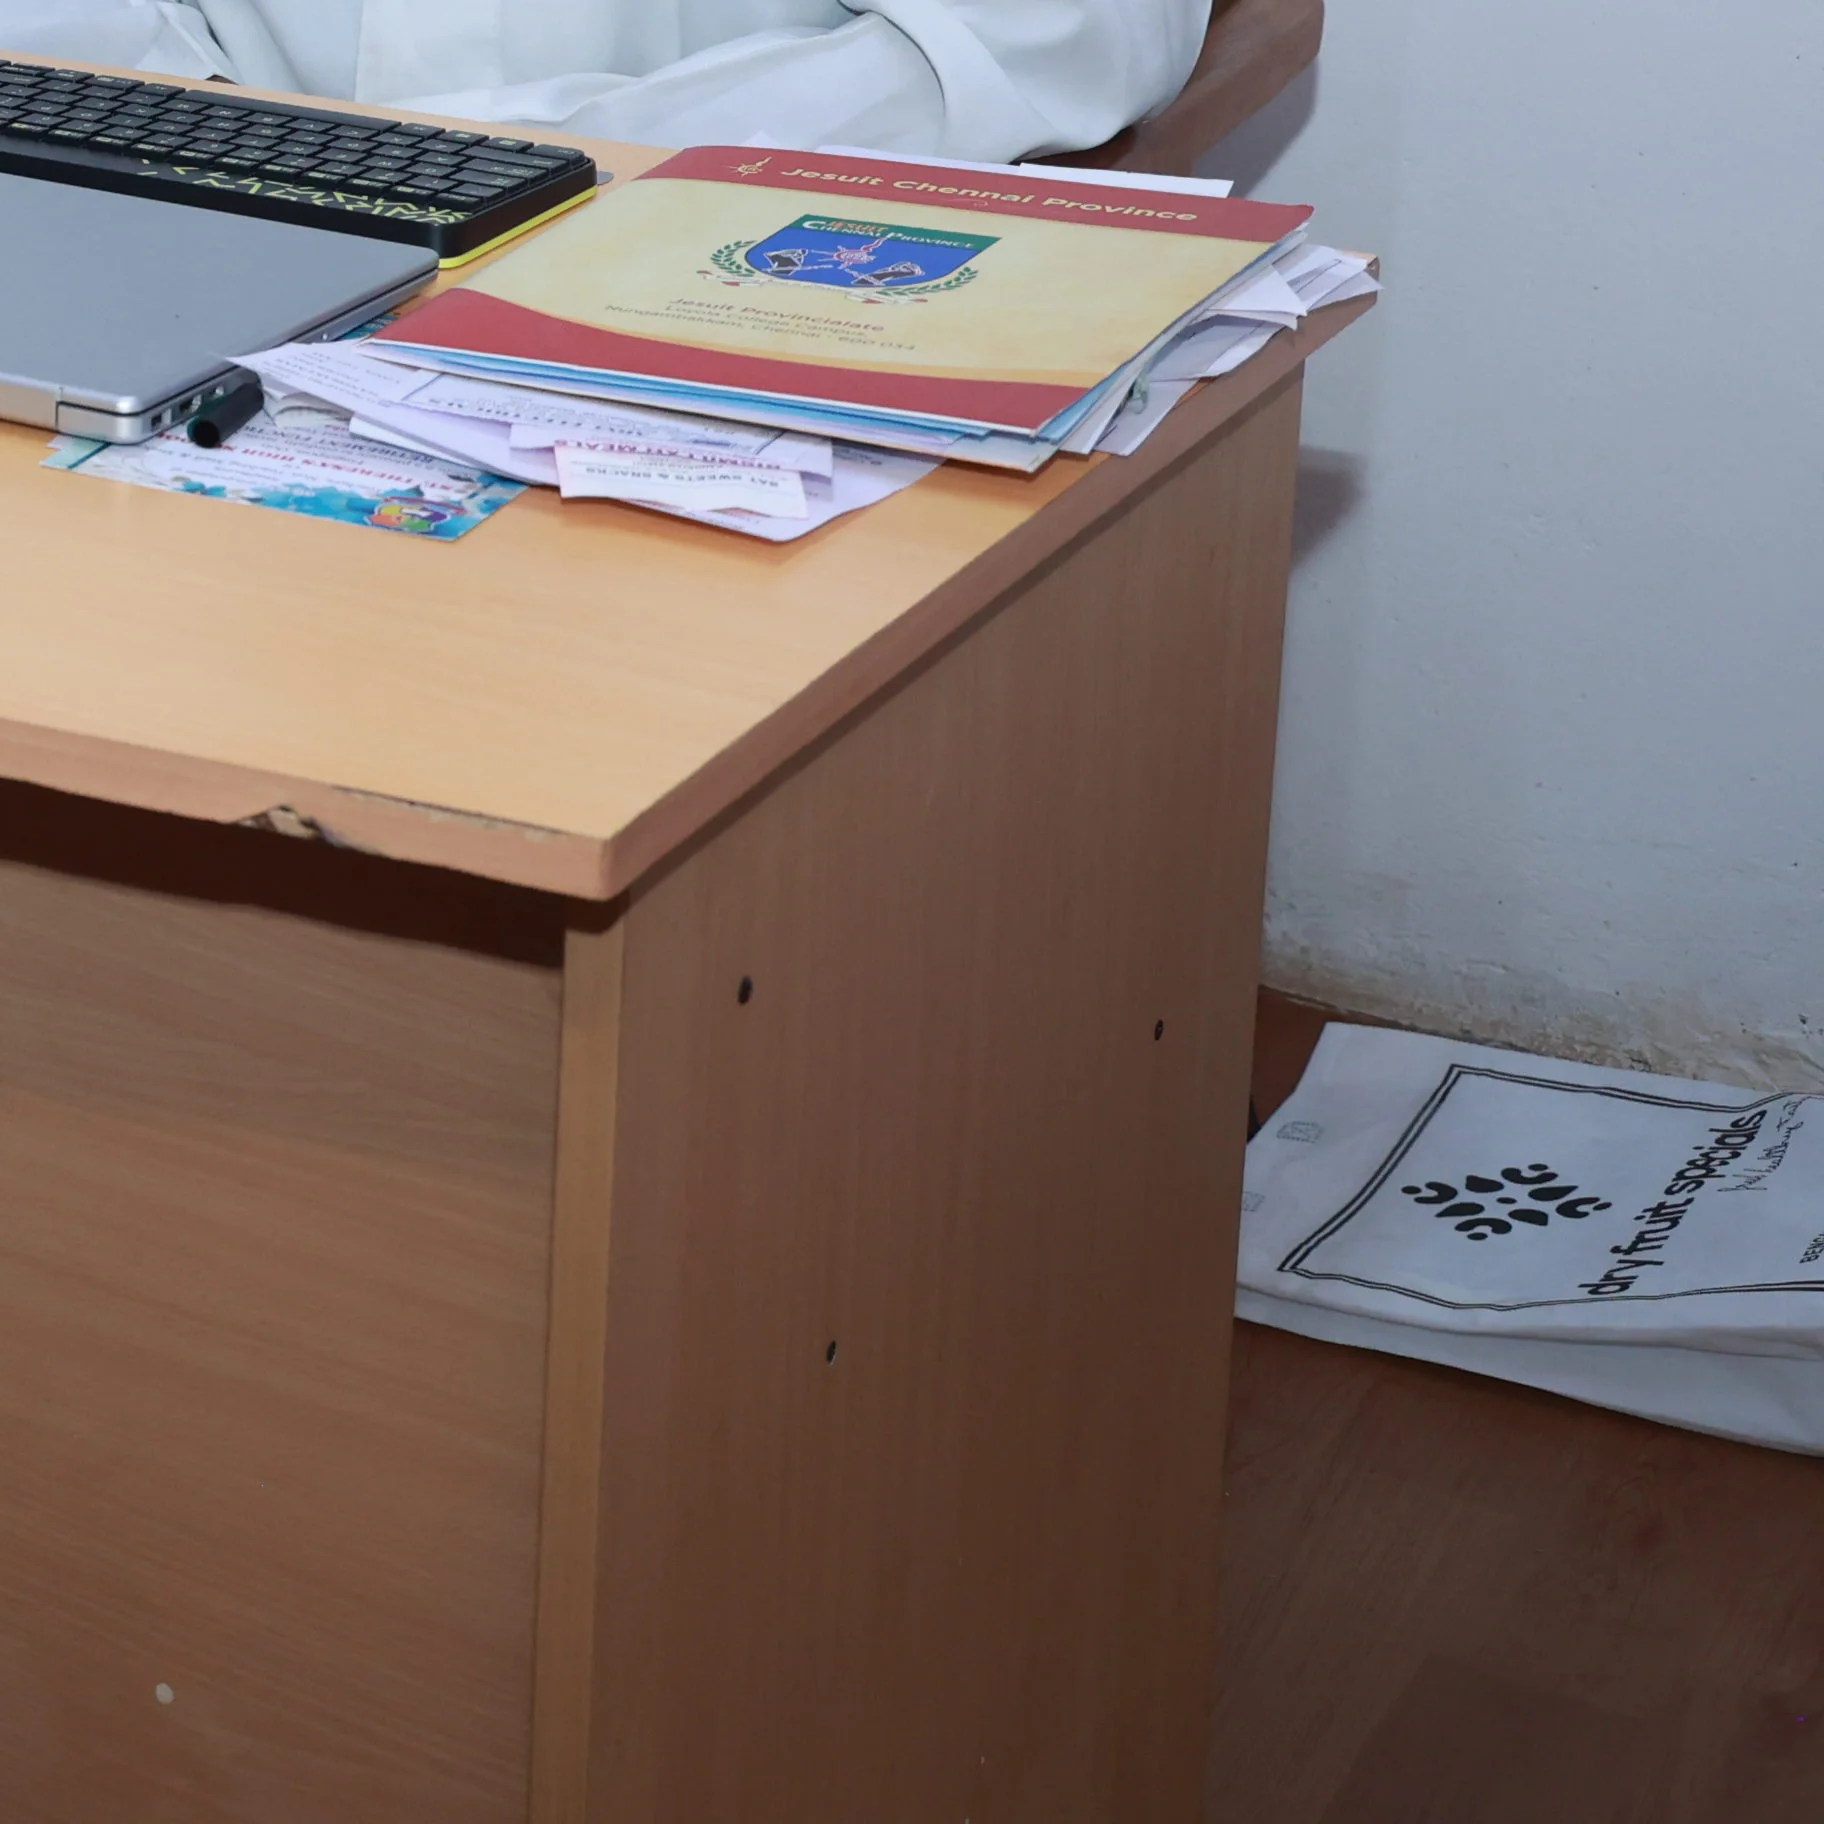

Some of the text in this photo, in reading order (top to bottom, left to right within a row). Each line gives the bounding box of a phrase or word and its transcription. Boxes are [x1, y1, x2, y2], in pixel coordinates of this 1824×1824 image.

[781, 166, 1199, 222] Jesuit Chennai Province
[802, 217, 976, 250] CHENNAI PROVINCE
[670, 298, 885, 332] Jesuit Provincialate
[241, 447, 290, 463] HIGH
[1578, 1109, 1768, 1296] dry fruit specials
